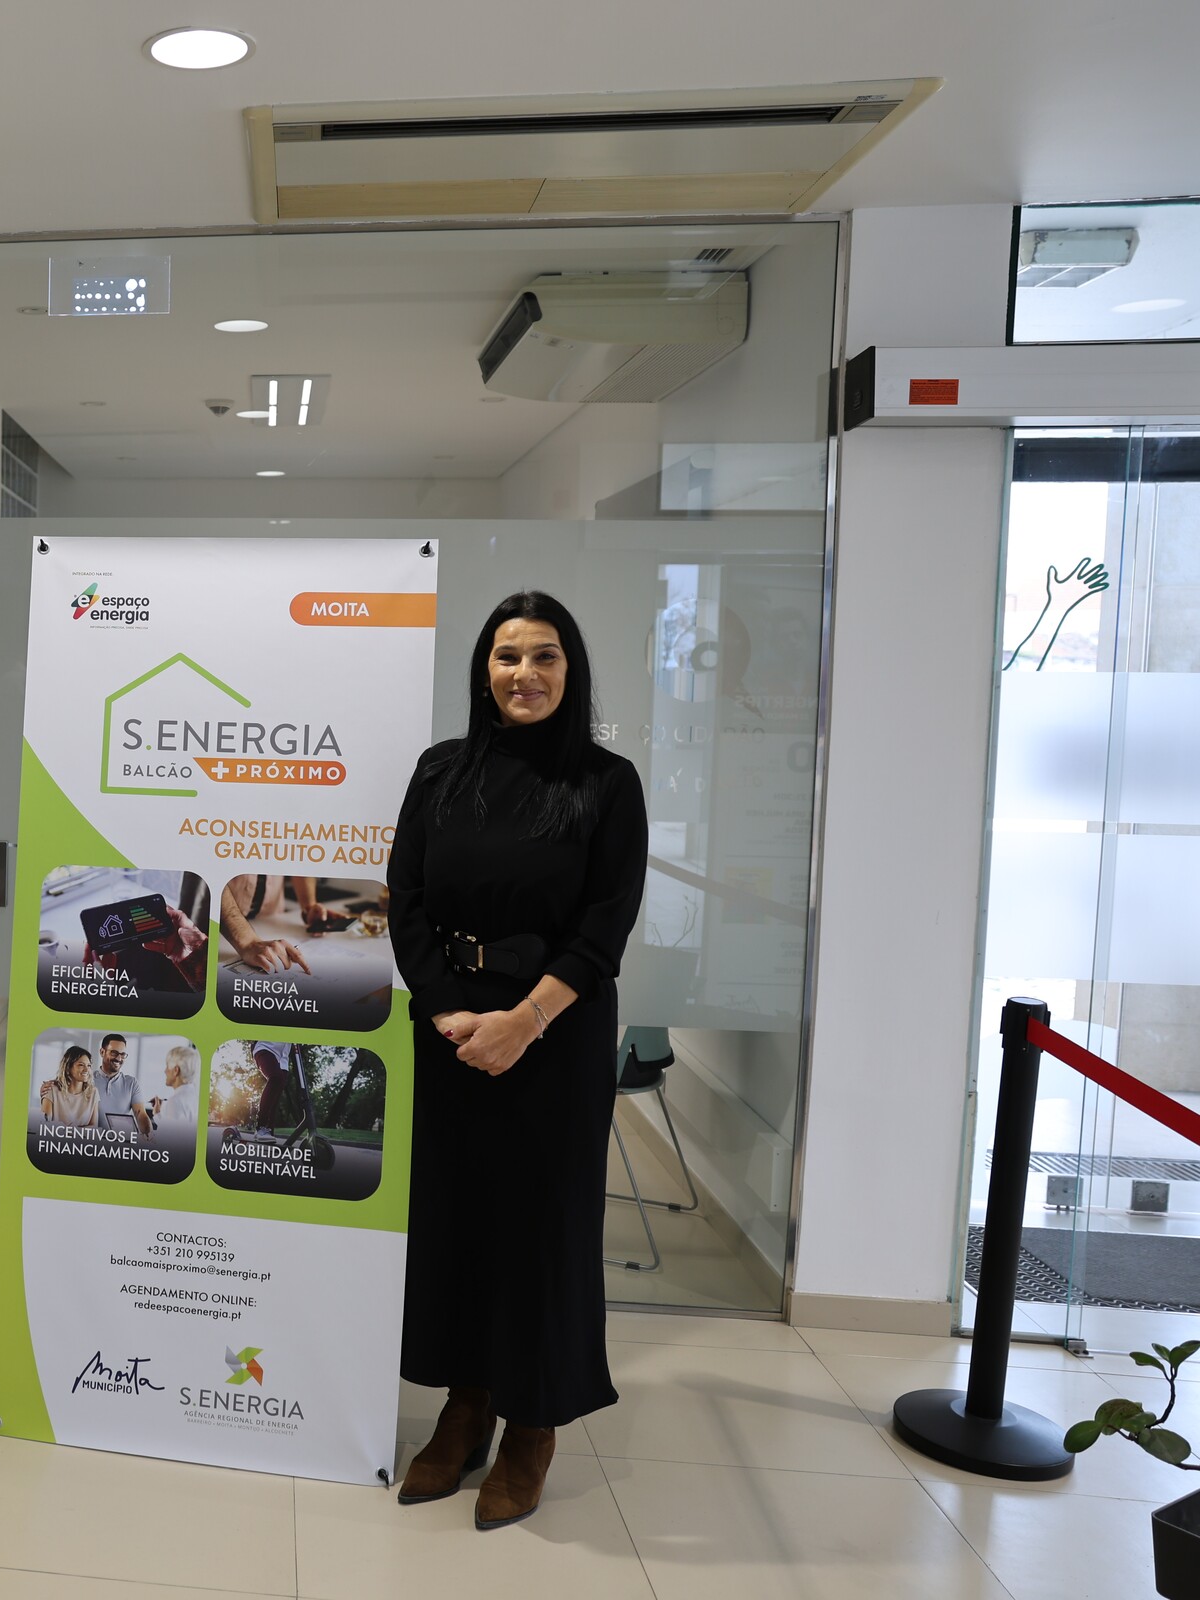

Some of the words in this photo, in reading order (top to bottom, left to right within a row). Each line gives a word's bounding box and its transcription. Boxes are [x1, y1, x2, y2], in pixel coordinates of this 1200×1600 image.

[102, 597, 150, 609] espaço
[311, 602, 370, 617] MOITA
[90, 608, 150, 624] energia
[122, 718, 342, 757] S.ENERGIA
[123, 763, 193, 779] BALCÃO
[236, 762, 341, 781] PRÓXIMO
[178, 817, 397, 845] ACONSELHAMENTO
[214, 840, 326, 863] GRATUITO
[52, 963, 130, 981] EFICIÊNCIA
[51, 980, 139, 998] ENERGÉTICA
[234, 979, 299, 995] ENERGIA
[233, 995, 319, 1013] RENOVÁVEL
[39, 1124, 126, 1143] INCENTIVOS
[130, 1131, 137, 1144] E
[38, 1140, 170, 1163] FINANCIAMENTOS
[220, 1143, 312, 1162] MOBILIDADE
[219, 1158, 316, 1179] SUSTENTÁVEL
[156, 1232, 227, 1248] CONTACTOS:
[147, 1246, 171, 1256] +351
[175, 1248, 193, 1258] 210
[196, 1249, 235, 1262] 995139
[110, 1254, 271, 1282] balcaomaisproximo@senergia.pt
[120, 1284, 208, 1302] AGENDAMENTO
[212, 1293, 257, 1308] ONLINE:
[134, 1300, 242, 1321] redeespacoenergia.pt
[71, 1351, 165, 1395] Moita
[82, 1380, 132, 1394] MUNICÍPIO
[179, 1387, 305, 1420] S.ENERGIA
[184, 1410, 215, 1420] AGÊNCIA
[218, 1414, 253, 1425] REGIONAL
[267, 1420, 299, 1430] ENERGIA
